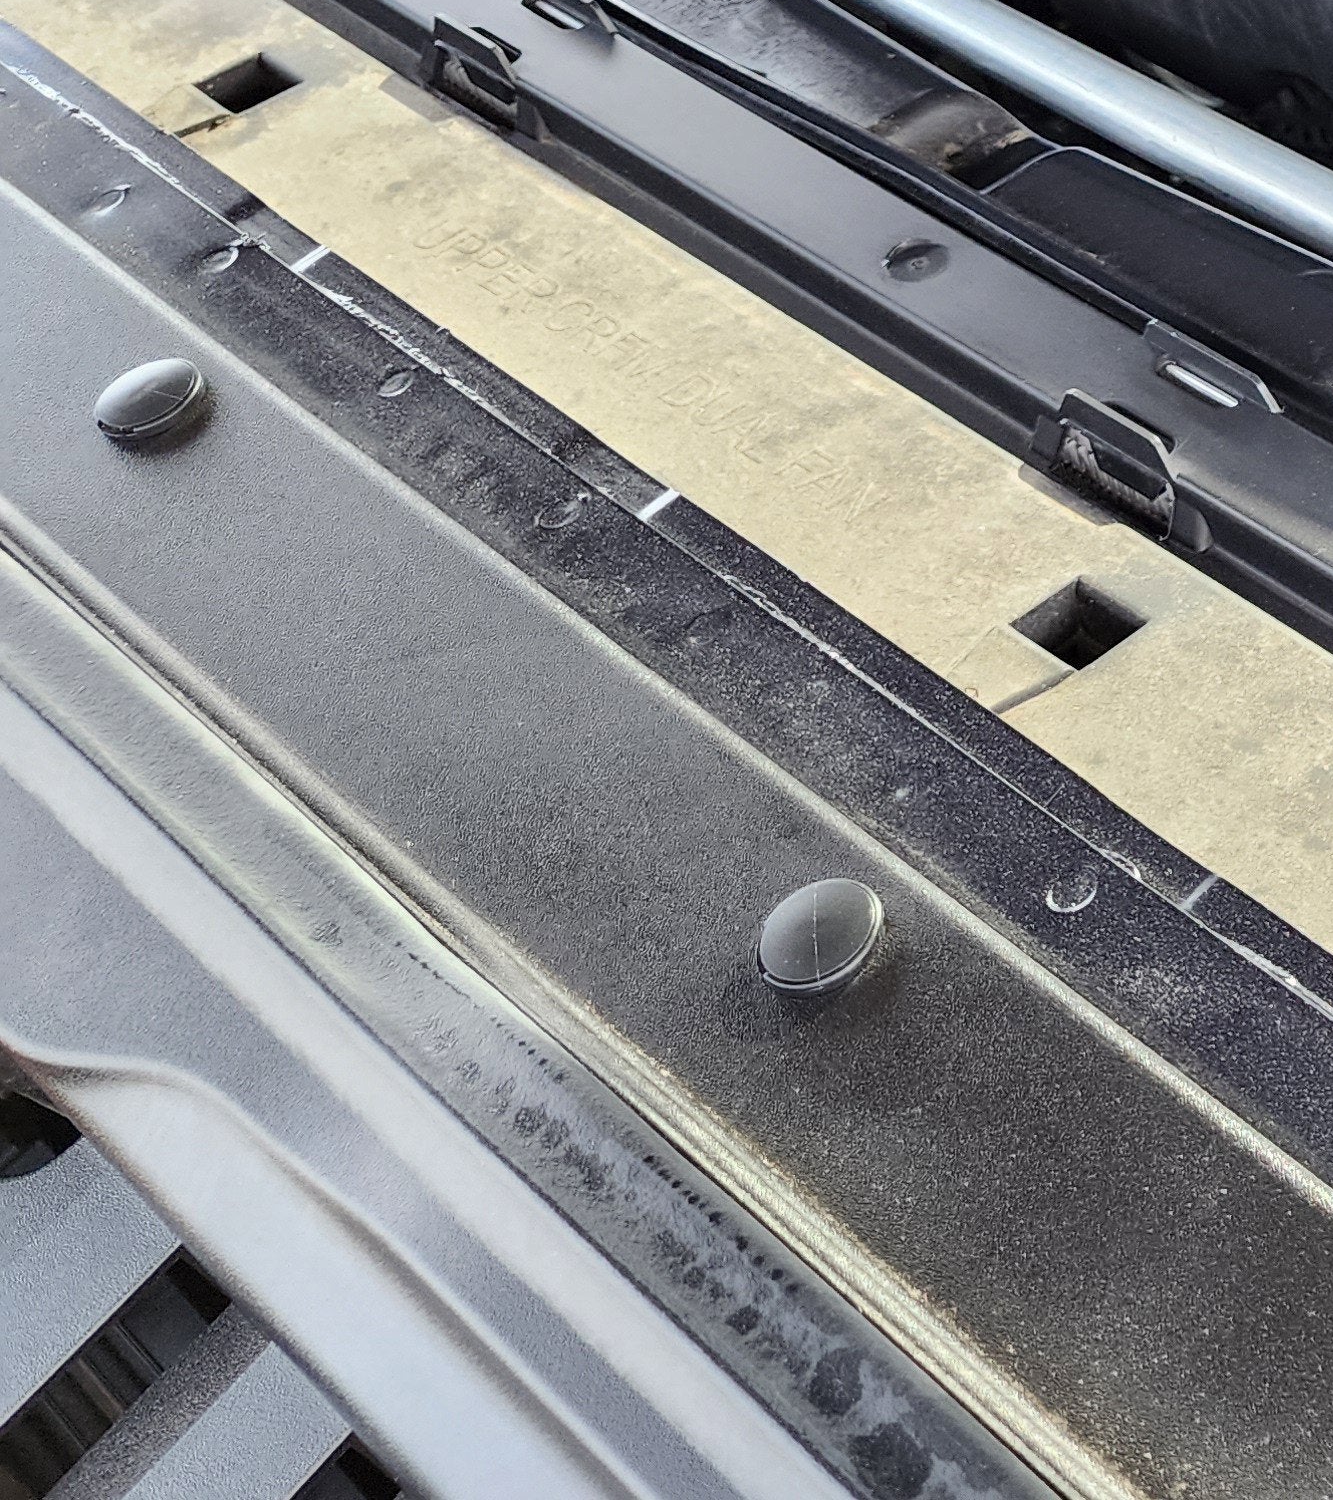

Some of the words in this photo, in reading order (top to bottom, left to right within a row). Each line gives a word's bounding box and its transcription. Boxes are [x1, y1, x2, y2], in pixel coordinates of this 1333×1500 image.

[414, 221, 559, 314] UPPER
[660, 373, 778, 465] DUAL
[776, 446, 884, 524] FAN
